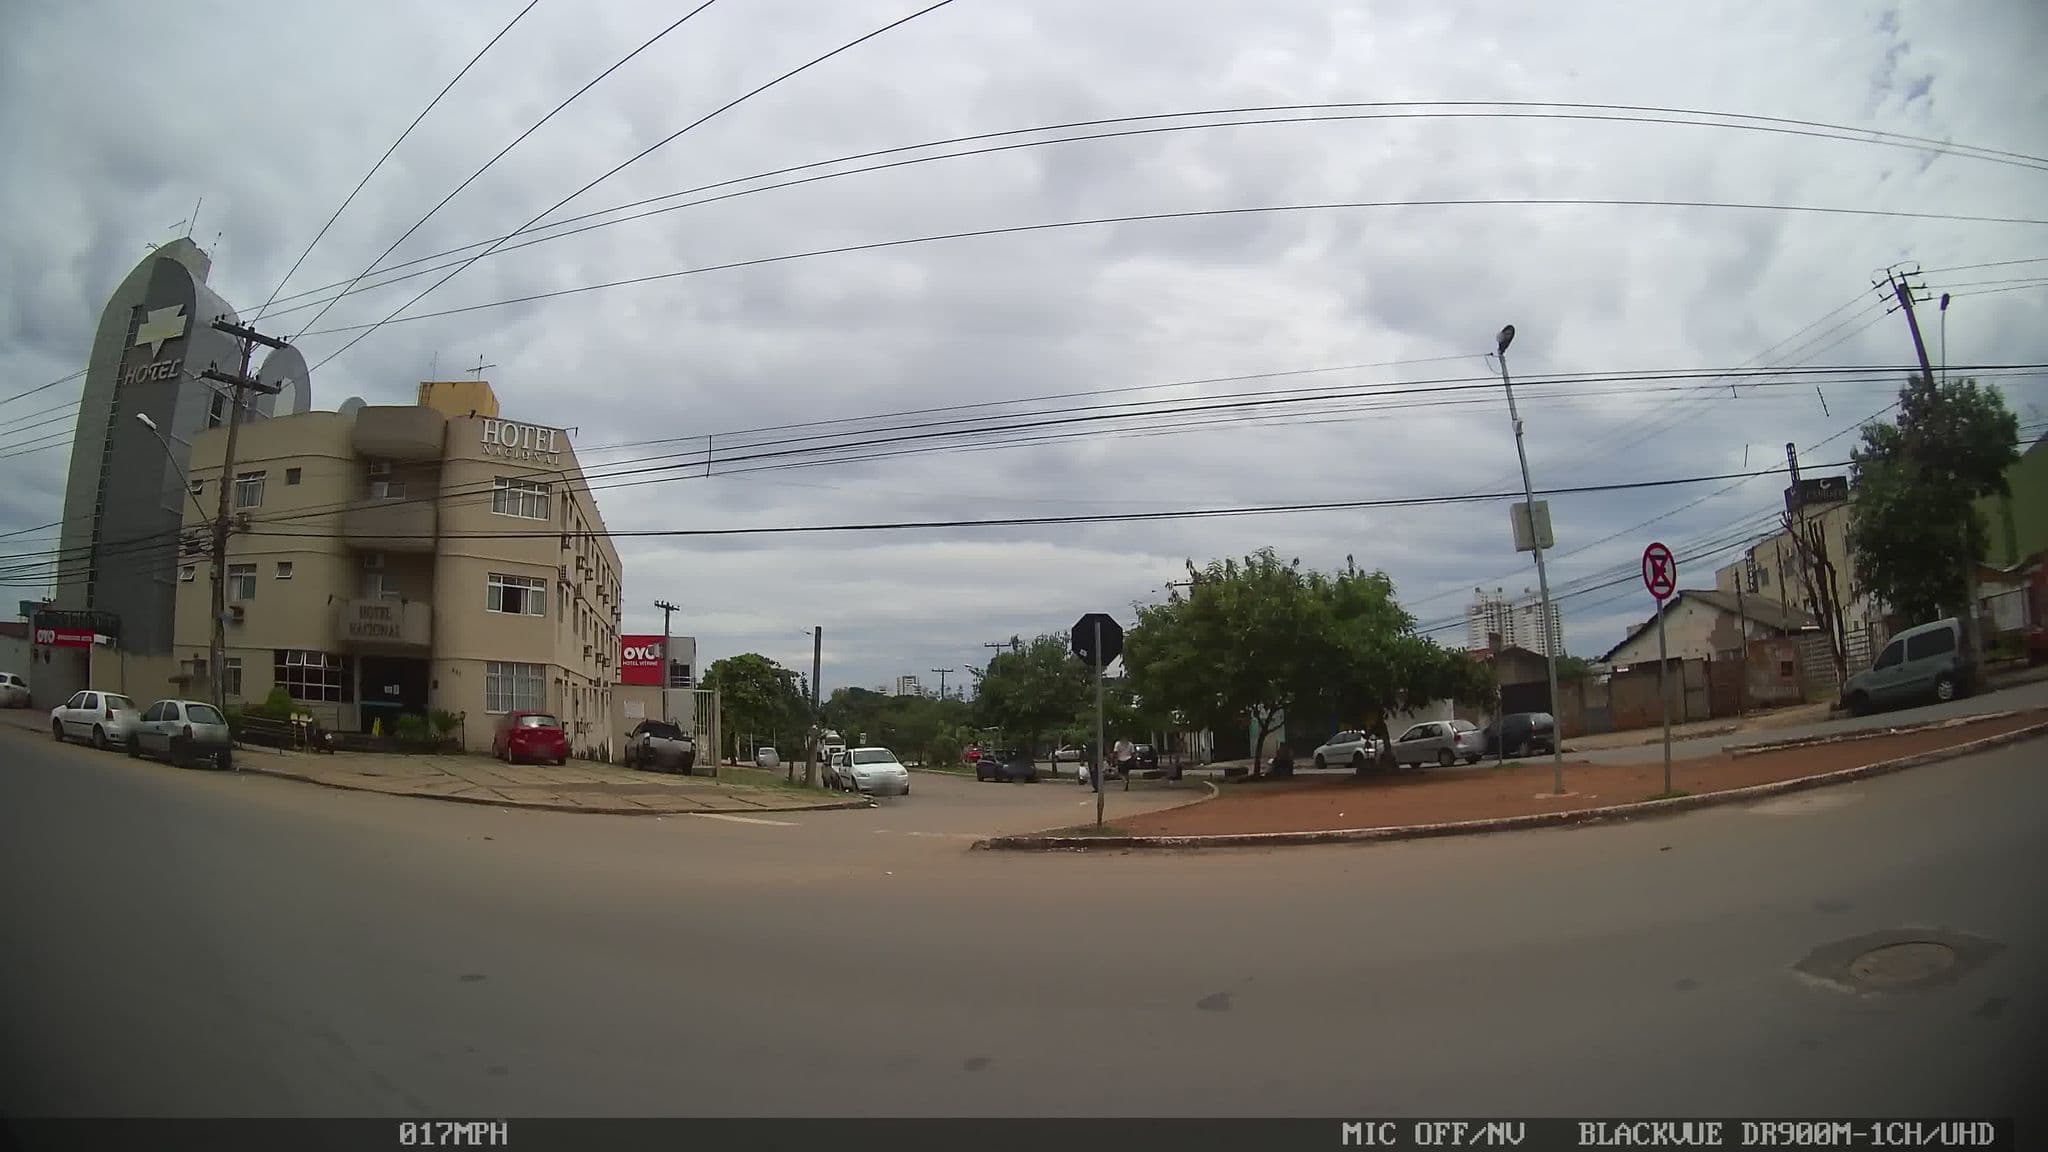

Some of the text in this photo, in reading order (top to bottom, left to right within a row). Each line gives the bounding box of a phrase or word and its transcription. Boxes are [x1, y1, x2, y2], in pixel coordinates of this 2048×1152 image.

[123, 359, 182, 385] HOTEL
[480, 419, 560, 454] HOTEL
[482, 444, 560, 465] NACIONAL
[359, 605, 392, 620] HOTEL
[349, 622, 400, 638] NACIONAL
